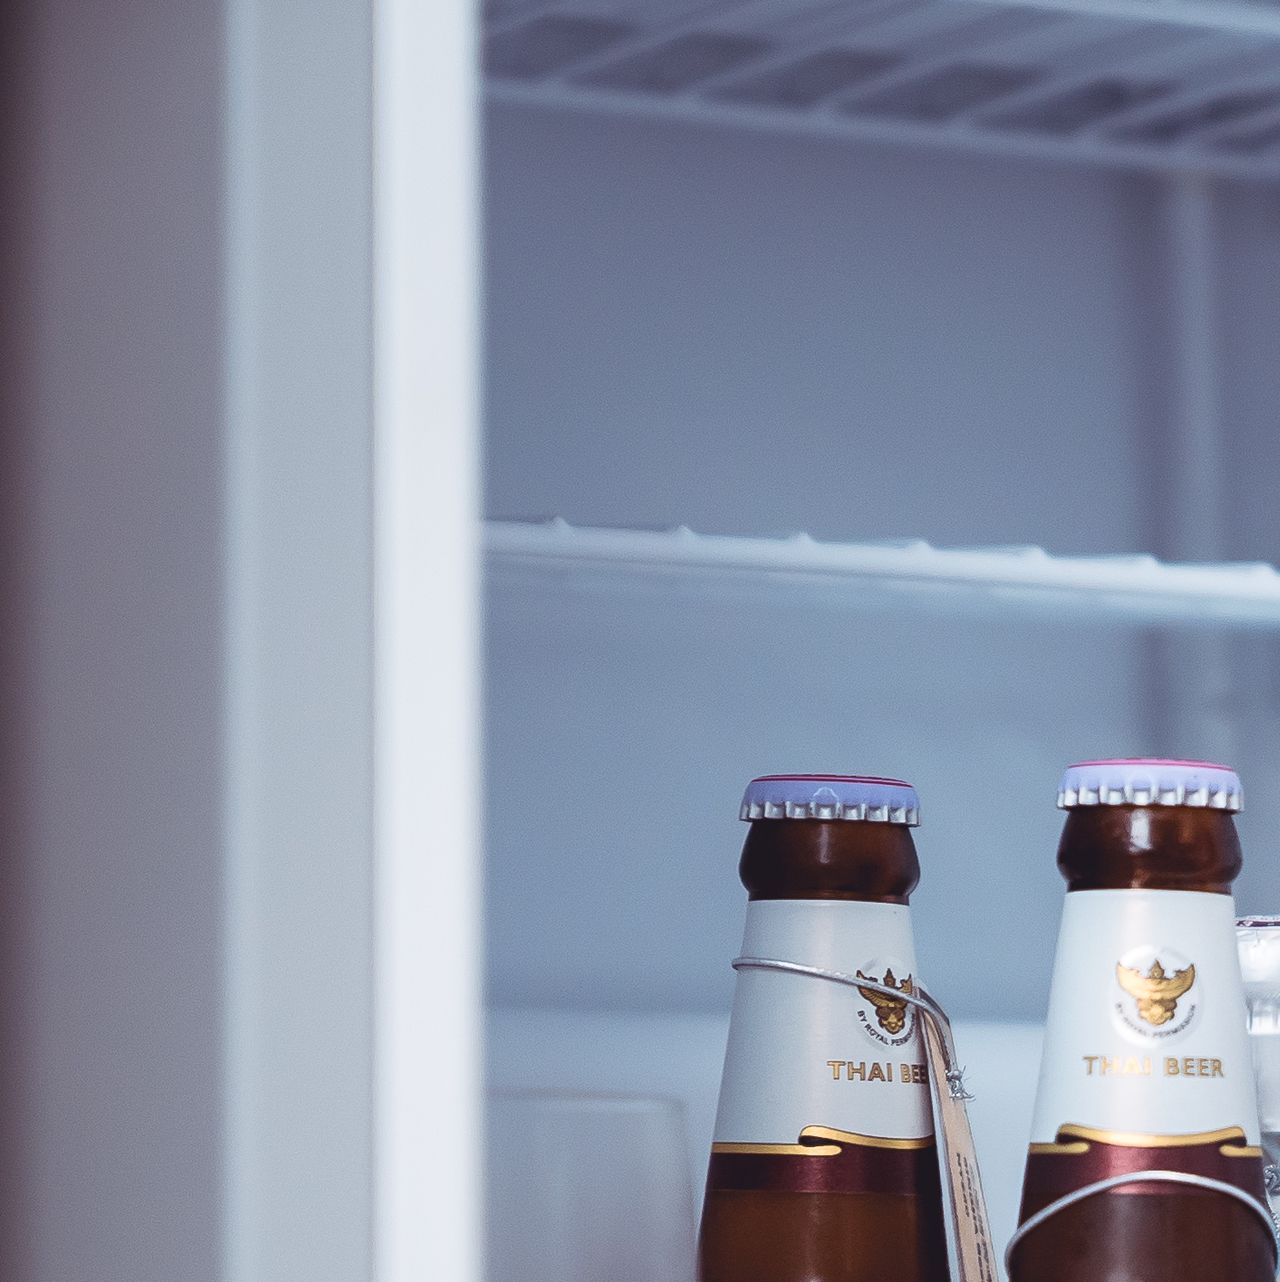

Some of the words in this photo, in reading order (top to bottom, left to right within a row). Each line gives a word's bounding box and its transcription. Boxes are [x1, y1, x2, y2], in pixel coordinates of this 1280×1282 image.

[827, 1060, 893, 1082] THAI
[900, 1063, 929, 1084] BEE
[1083, 1055, 1152, 1077] THAI
[1165, 1056, 1224, 1078] BEER
